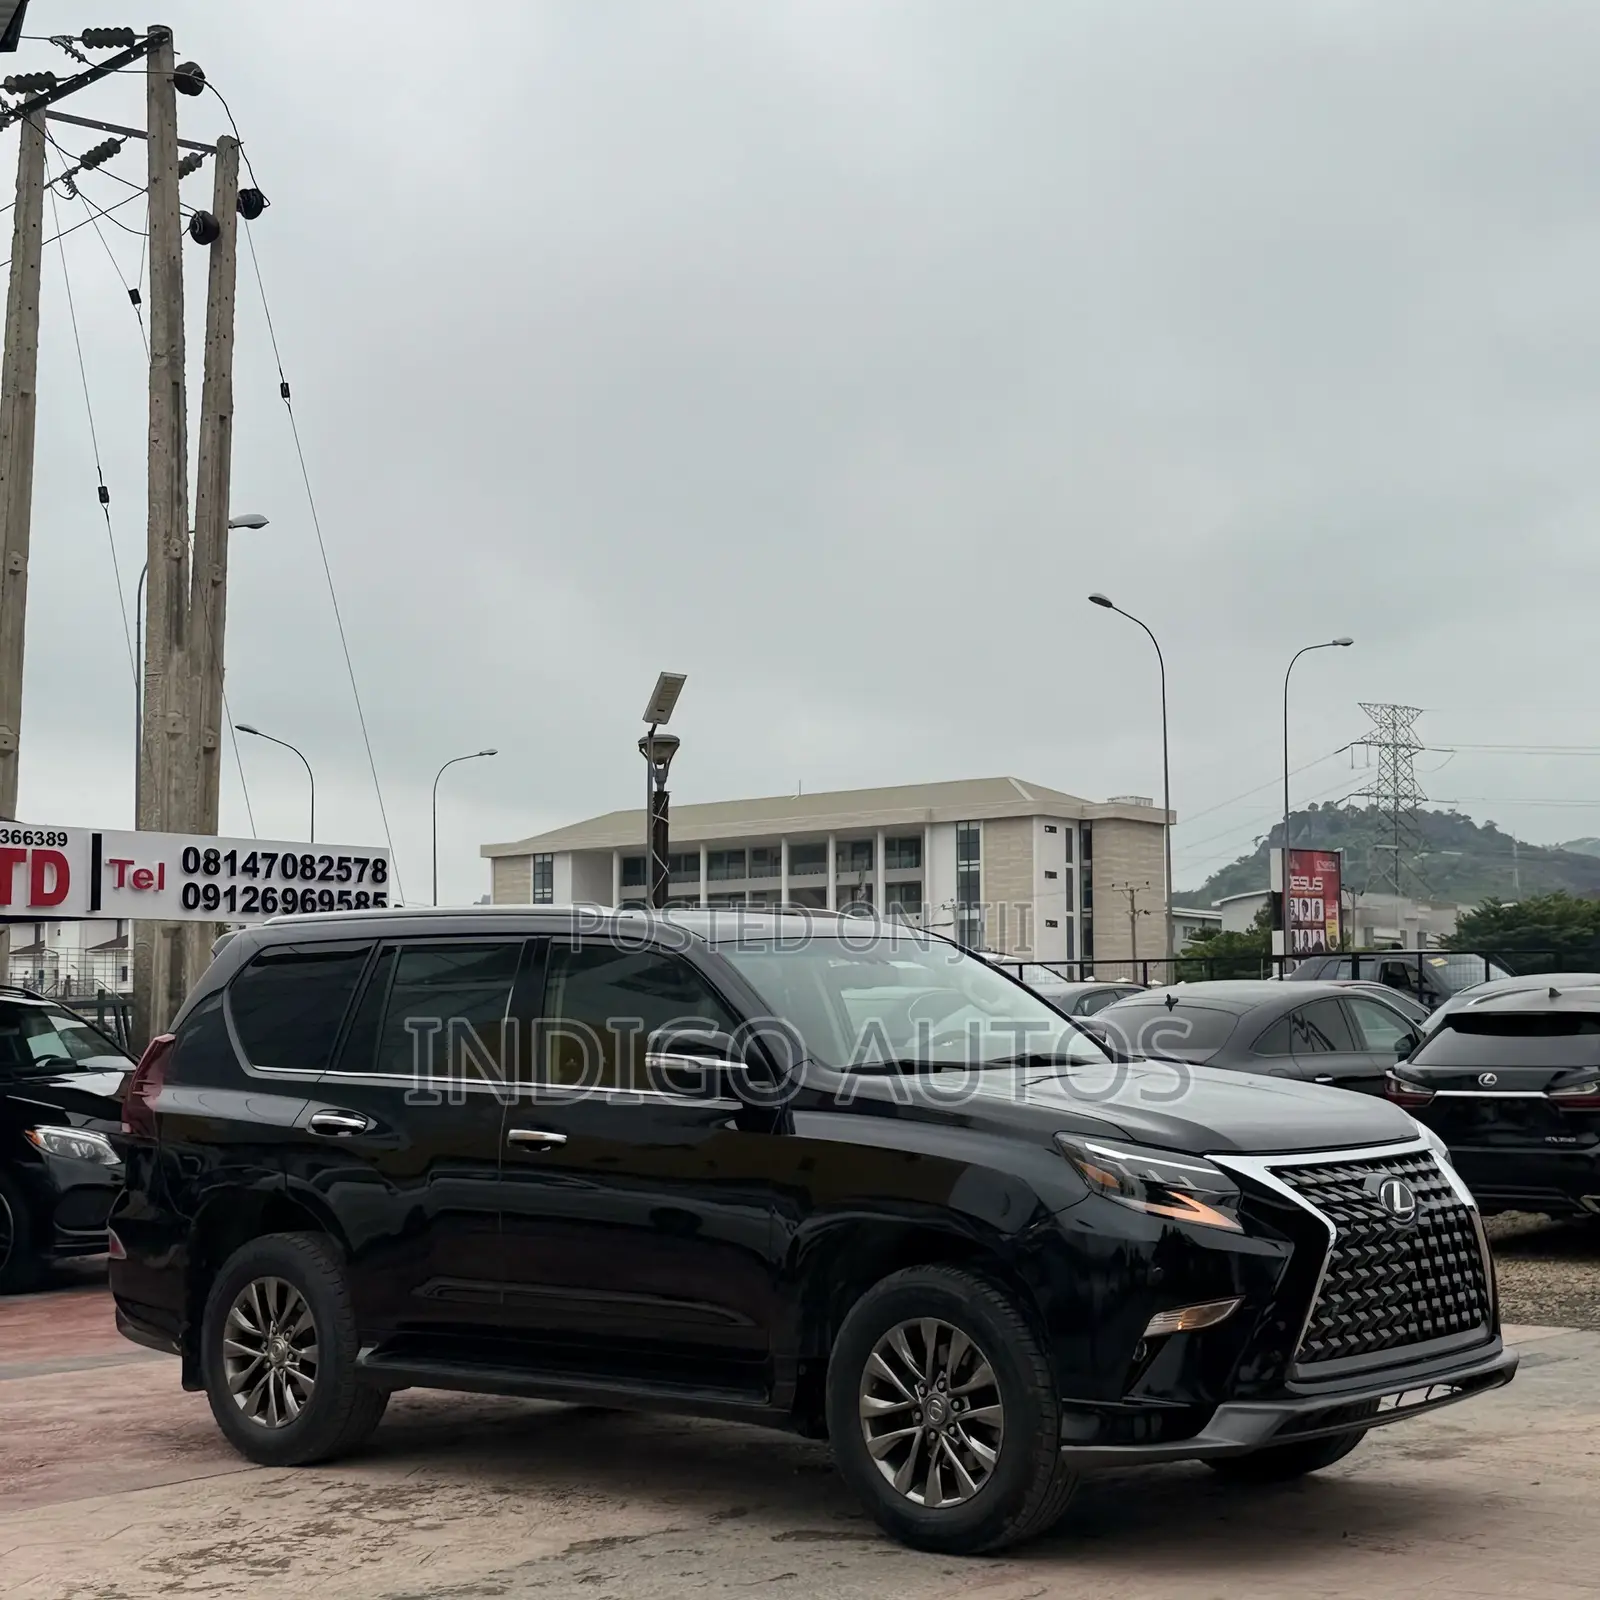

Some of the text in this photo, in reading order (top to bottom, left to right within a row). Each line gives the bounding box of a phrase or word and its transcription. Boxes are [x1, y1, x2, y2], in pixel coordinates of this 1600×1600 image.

[0, 829, 68, 847] 366389
[108, 858, 165, 890] Tel
[182, 847, 388, 884] 08147082578
[182, 882, 388, 915] 09126969585
